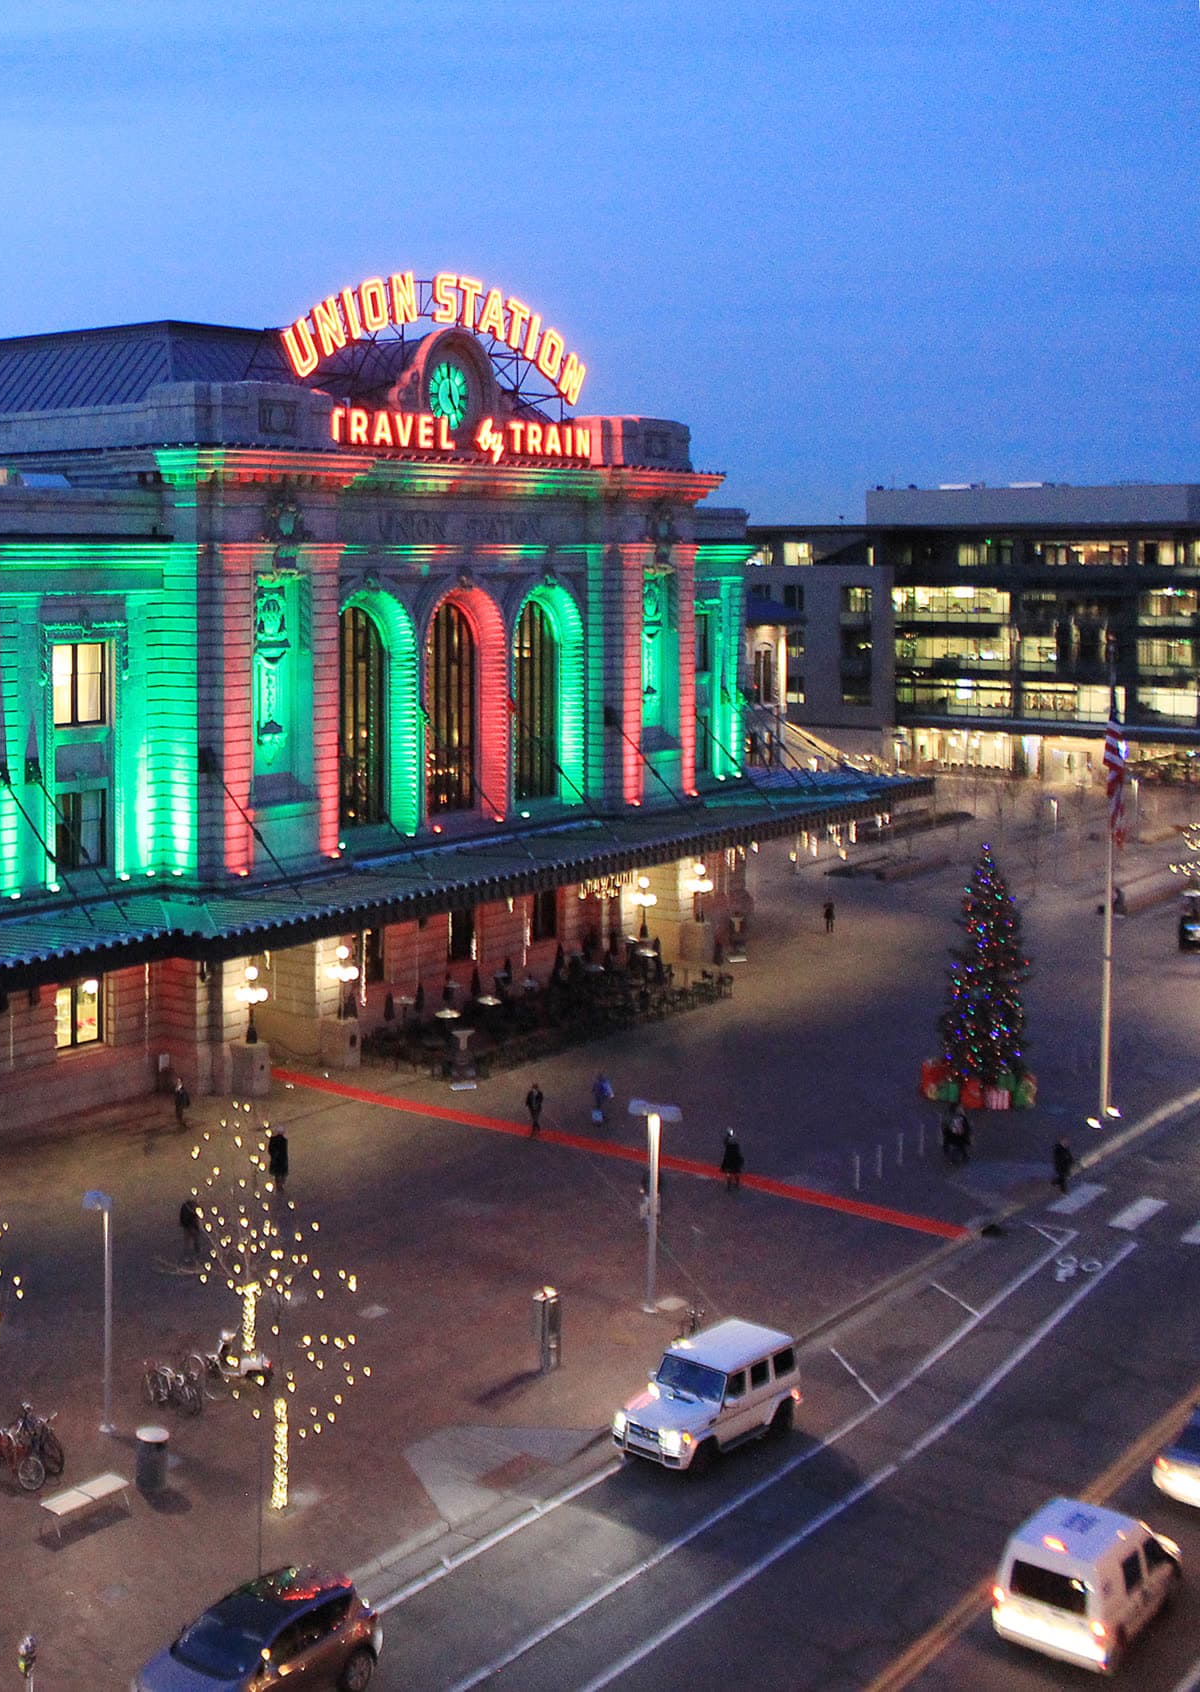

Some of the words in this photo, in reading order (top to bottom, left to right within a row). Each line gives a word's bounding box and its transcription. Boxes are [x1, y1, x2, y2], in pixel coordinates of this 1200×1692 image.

[281, 270, 418, 378] UNION
[432, 272, 587, 406] STATION
[331, 406, 456, 451] TRAVEL
[475, 416, 505, 465] by
[506, 419, 592, 459] TRAIN
[377, 511, 447, 540] UNION
[465, 512, 543, 541] STATION
